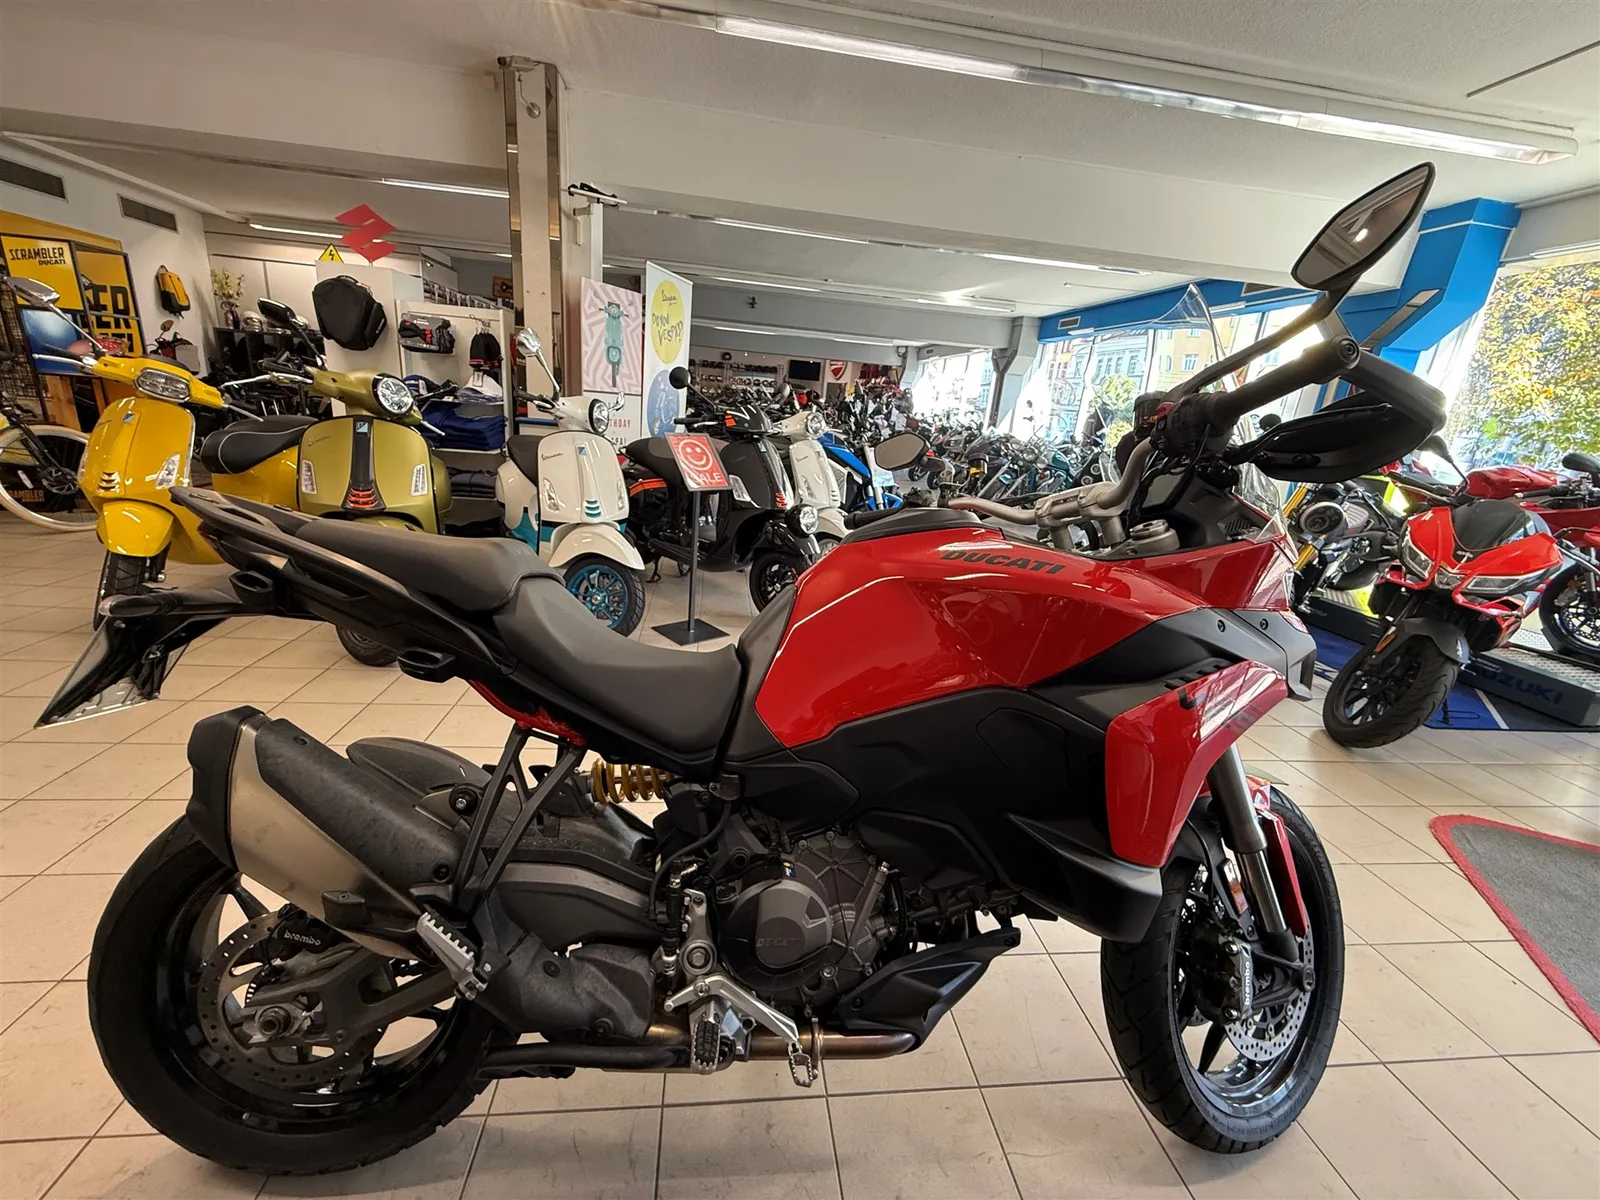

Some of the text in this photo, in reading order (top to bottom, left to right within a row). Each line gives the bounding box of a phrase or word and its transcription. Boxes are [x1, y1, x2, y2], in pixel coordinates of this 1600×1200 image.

[9, 247, 65, 260] SCRAMBLER
[38, 258, 66, 266] DUCATI
[940, 550, 1066, 575] DUCATI
[1481, 669, 1563, 704] UZUKI
[284, 929, 321, 946] brembo
